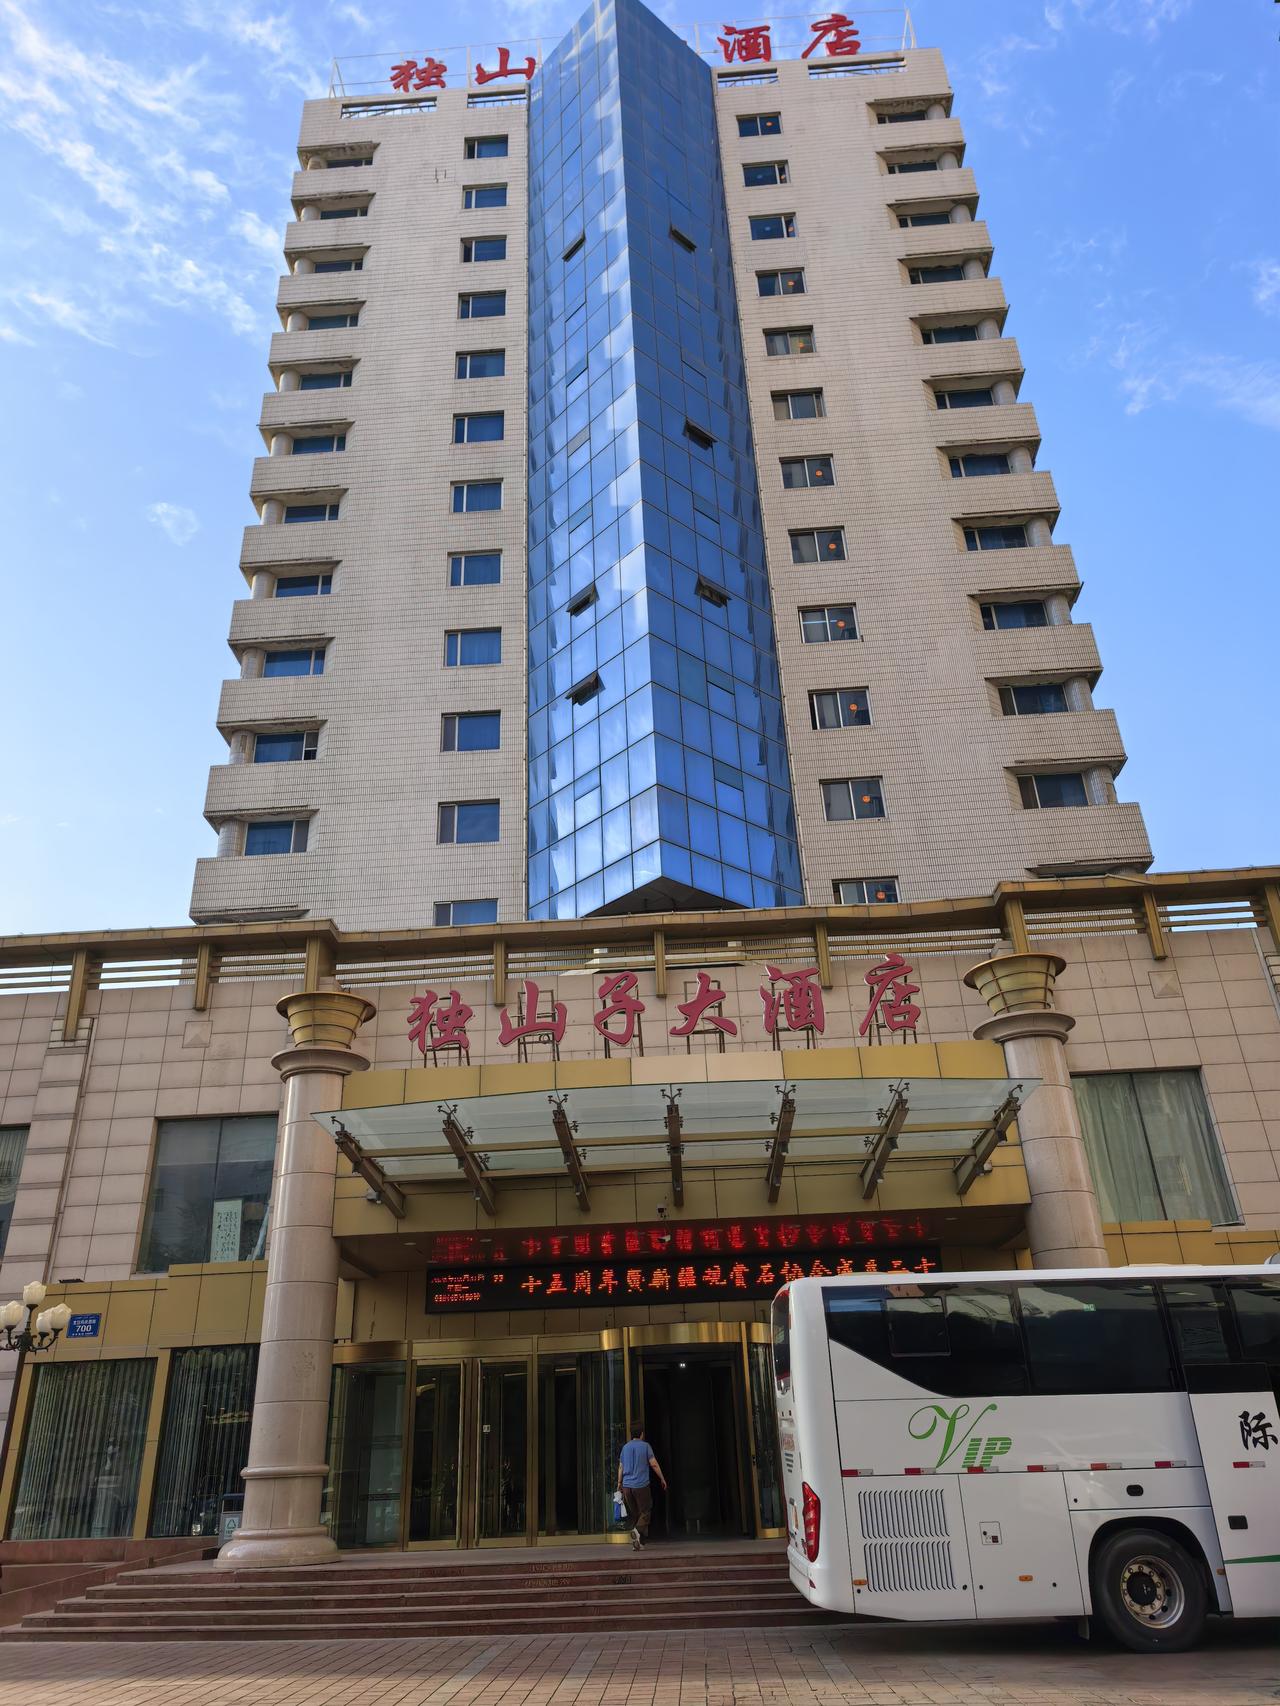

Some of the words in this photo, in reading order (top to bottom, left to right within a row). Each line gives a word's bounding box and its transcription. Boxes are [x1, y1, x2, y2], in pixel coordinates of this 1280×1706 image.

[390, 47, 537, 92] 独山
[717, 13, 862, 63] 酒店
[406, 953, 923, 1055] 独山子大酒店
[907, 1403, 1012, 1469] VIP
[1238, 1410, 1279, 1451] 际
